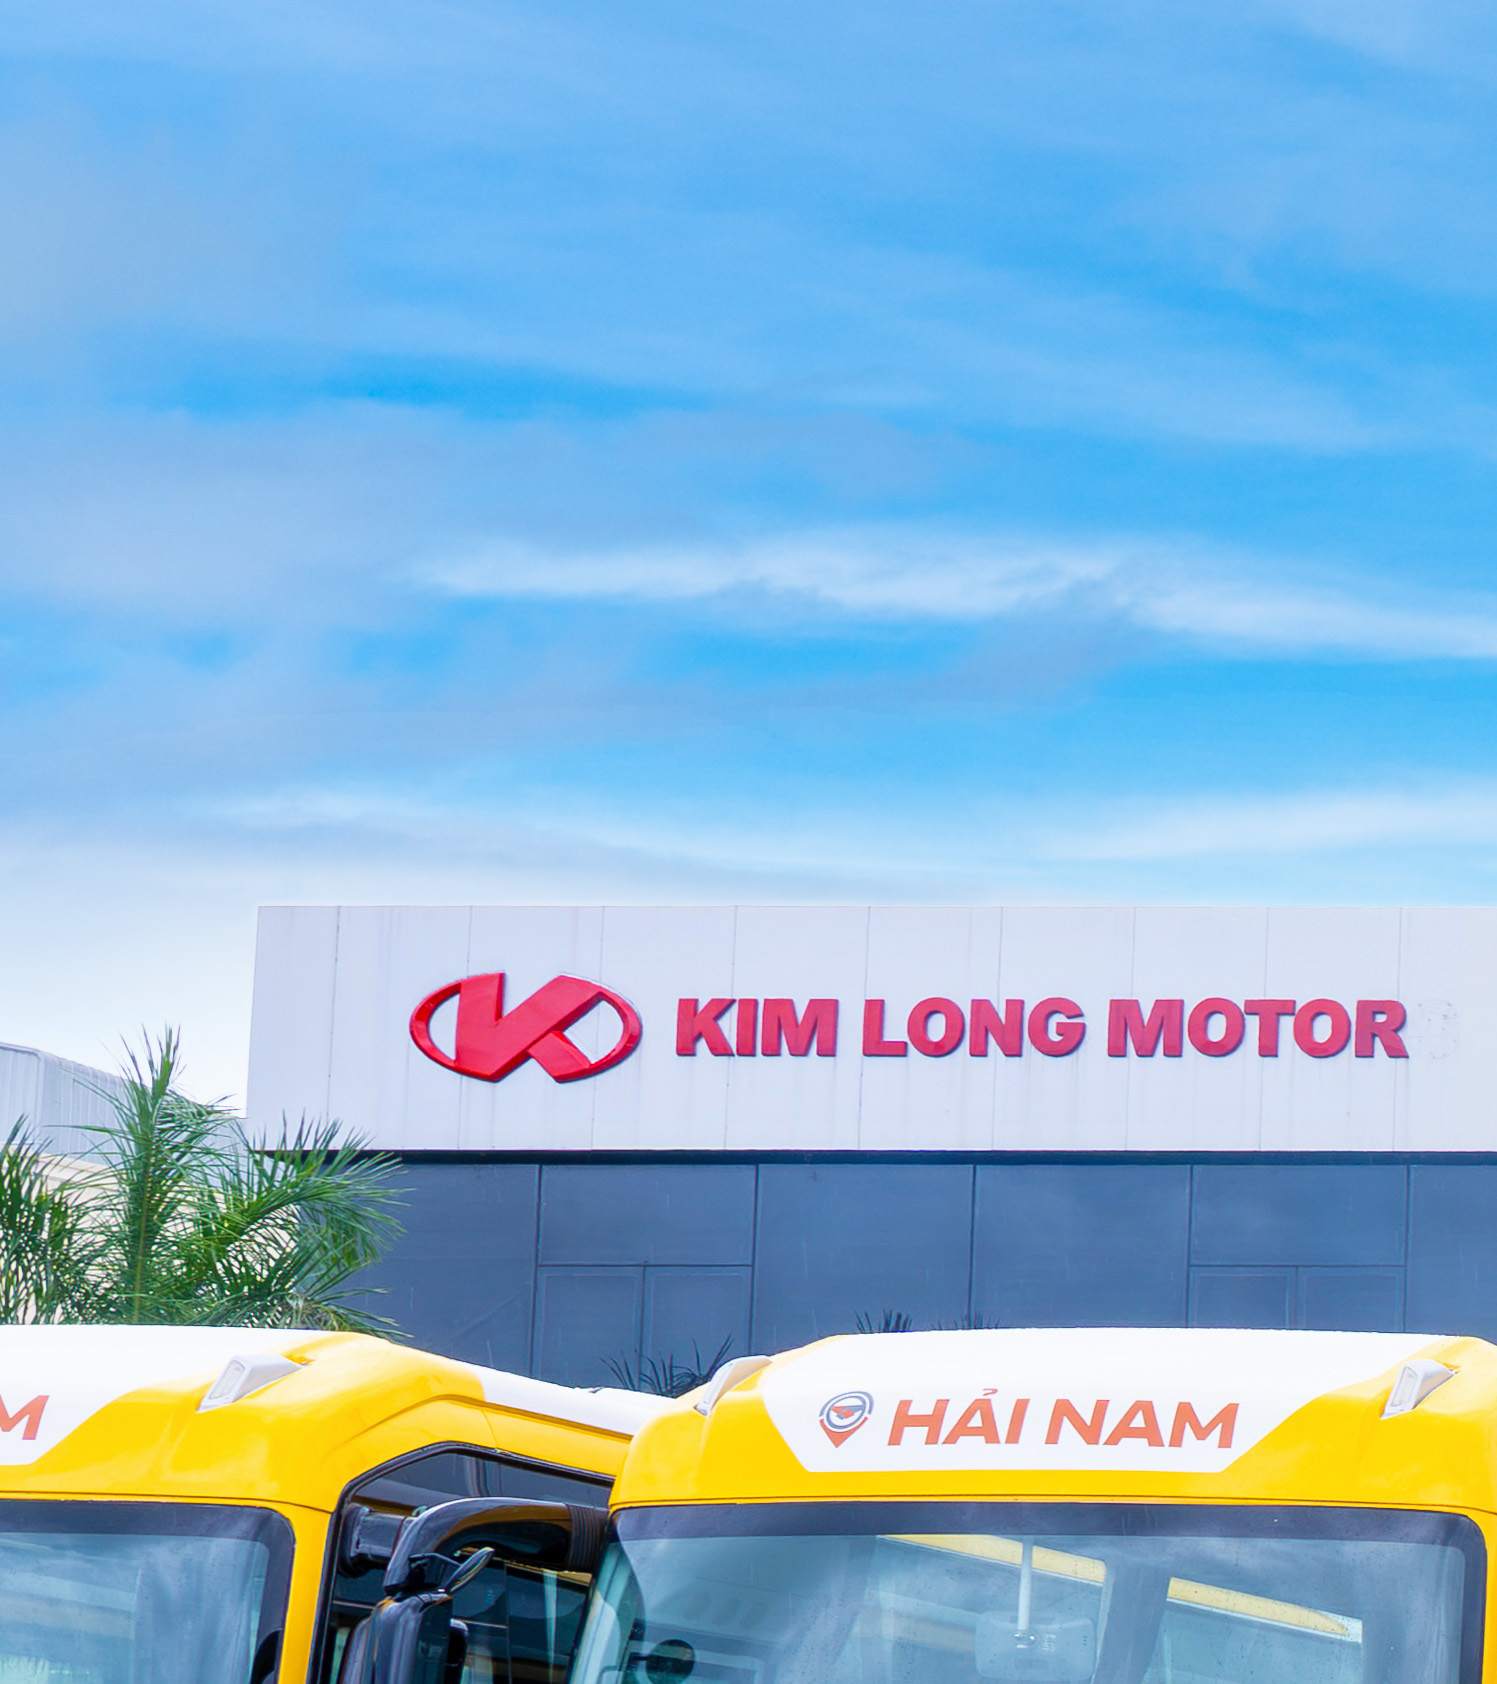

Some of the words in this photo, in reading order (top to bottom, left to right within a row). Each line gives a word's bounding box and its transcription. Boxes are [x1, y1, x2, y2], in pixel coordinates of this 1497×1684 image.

[675, 998, 837, 1058] KIM
[861, 996, 1087, 1058] LONG
[1107, 996, 1409, 1059] MOTOR
[887, 1388, 1031, 1446] HẢI
[1044, 1399, 1240, 1448] NAM
